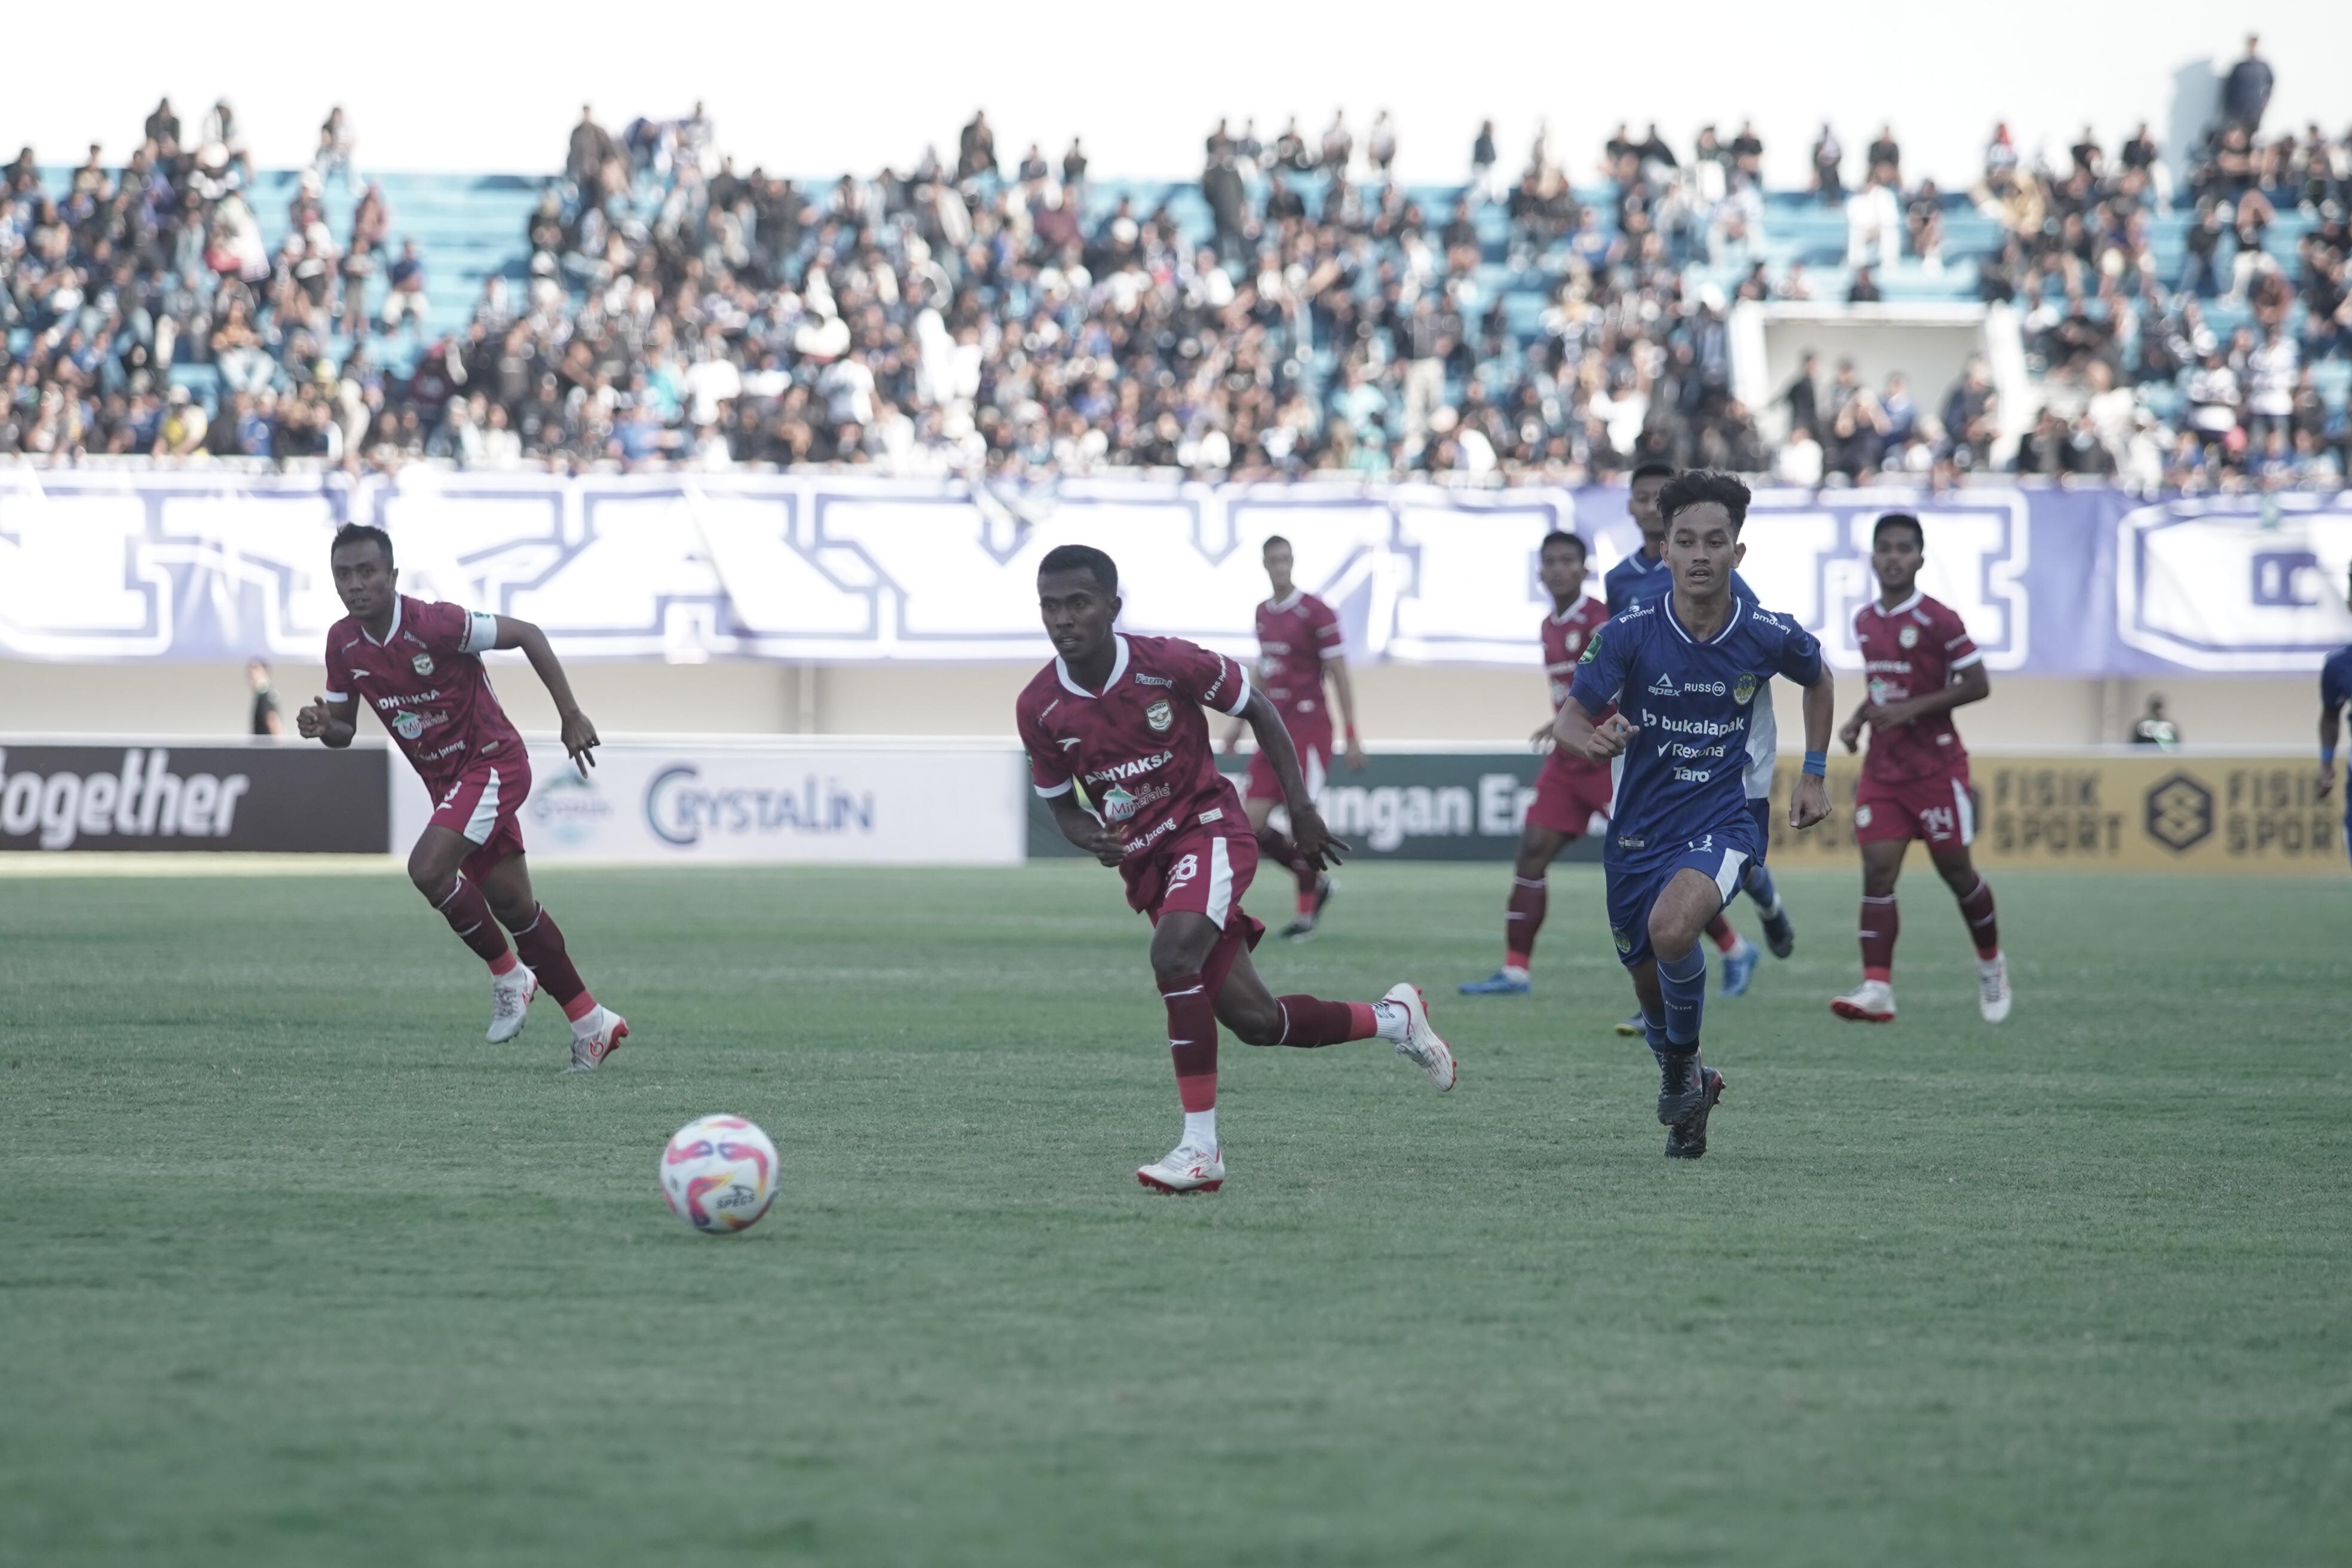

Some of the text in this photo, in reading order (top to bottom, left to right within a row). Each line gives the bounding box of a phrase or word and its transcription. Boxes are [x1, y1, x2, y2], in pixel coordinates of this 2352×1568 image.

[1619, 606, 1655, 624] bmoney
[1753, 611, 1791, 635] bmoney
[1648, 685, 1682, 697] apex
[1661, 716, 1744, 737] bukalapak
[1673, 743, 1725, 758] Rexona
[1085, 751, 1174, 785] ADHYAKSA
[1673, 767, 1710, 783] Taro
[0, 749, 250, 850] ogether
[1111, 786, 1170, 815] Minerale
[1127, 817, 1177, 853] ank Jateng
[2227, 813, 2334, 856] SPOR
[716, 1196, 755, 1209] SPECS
